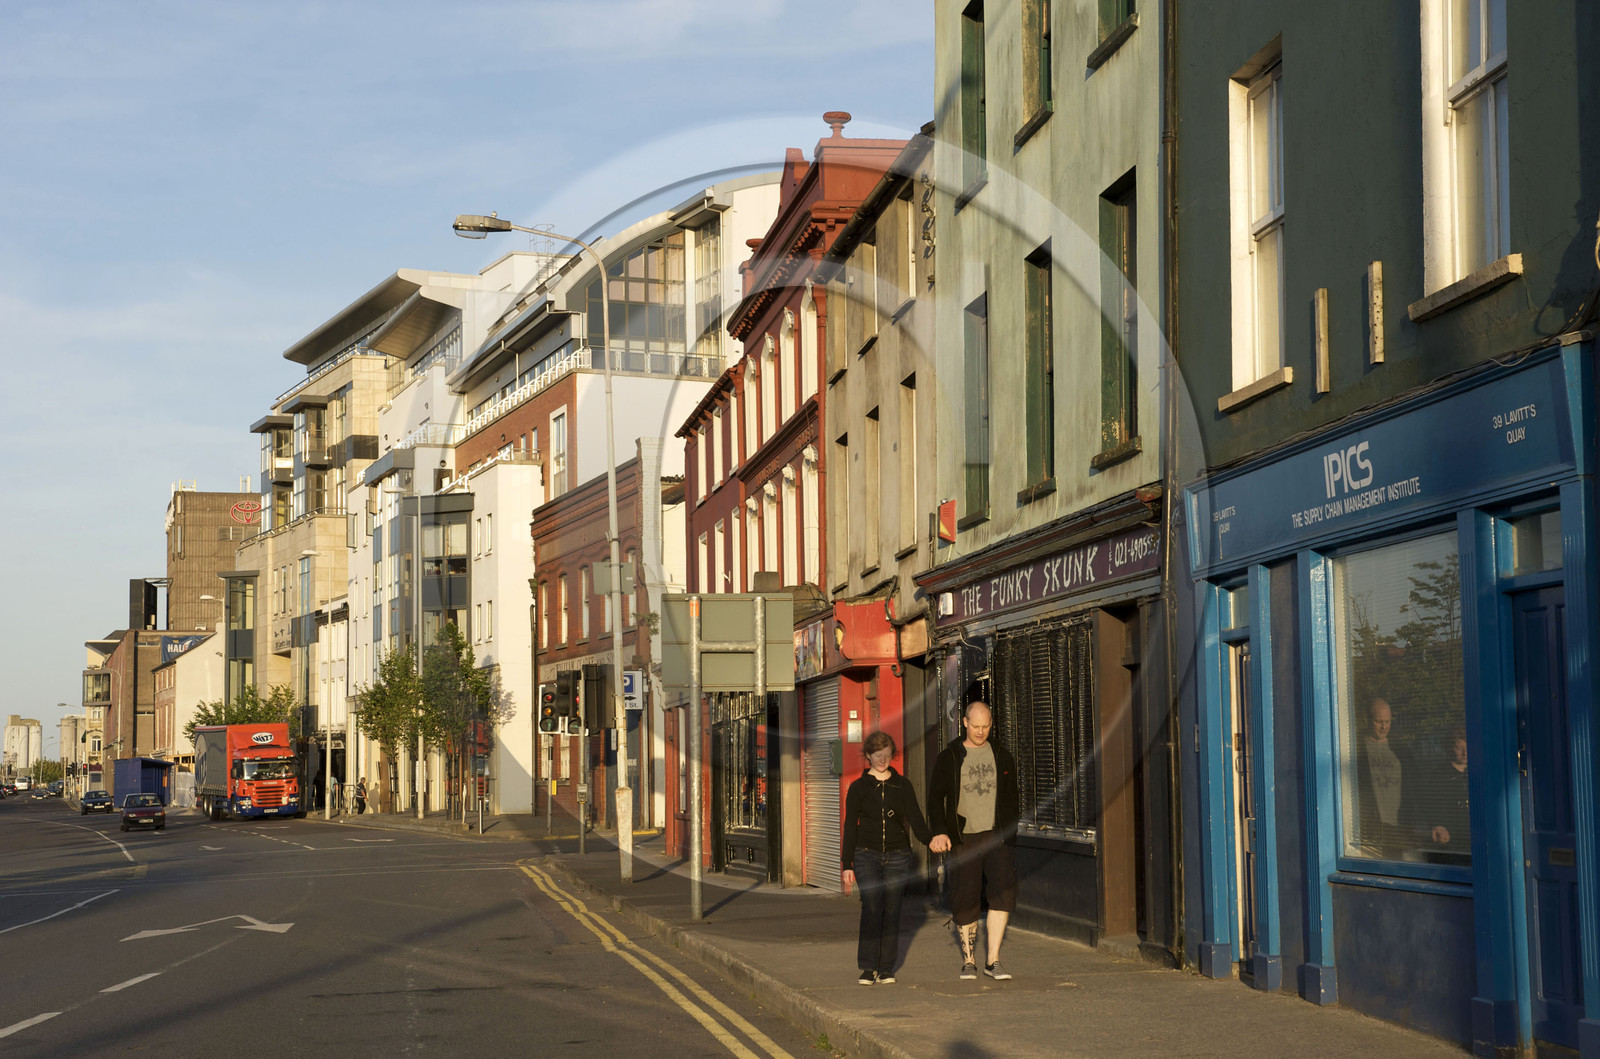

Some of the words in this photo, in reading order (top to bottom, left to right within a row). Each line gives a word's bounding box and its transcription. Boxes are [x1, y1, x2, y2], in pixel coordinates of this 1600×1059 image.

[1492, 415, 1503, 430] 39
[1504, 403, 1537, 426] LAVITT'S
[1506, 426, 1526, 444] QUAY
[1323, 440, 1374, 499] IPICS
[1292, 512, 1303, 529] THE
[1303, 505, 1324, 526] SUPPLY
[1324, 500, 1343, 520] CHAIN
[1343, 487, 1387, 515] MANAGEMENT
[1387, 476, 1421, 502] INSTITUTE
[961, 583, 983, 616] THE
[990, 565, 1034, 611] FUNKY
[1042, 545, 1099, 597] SKUNK
